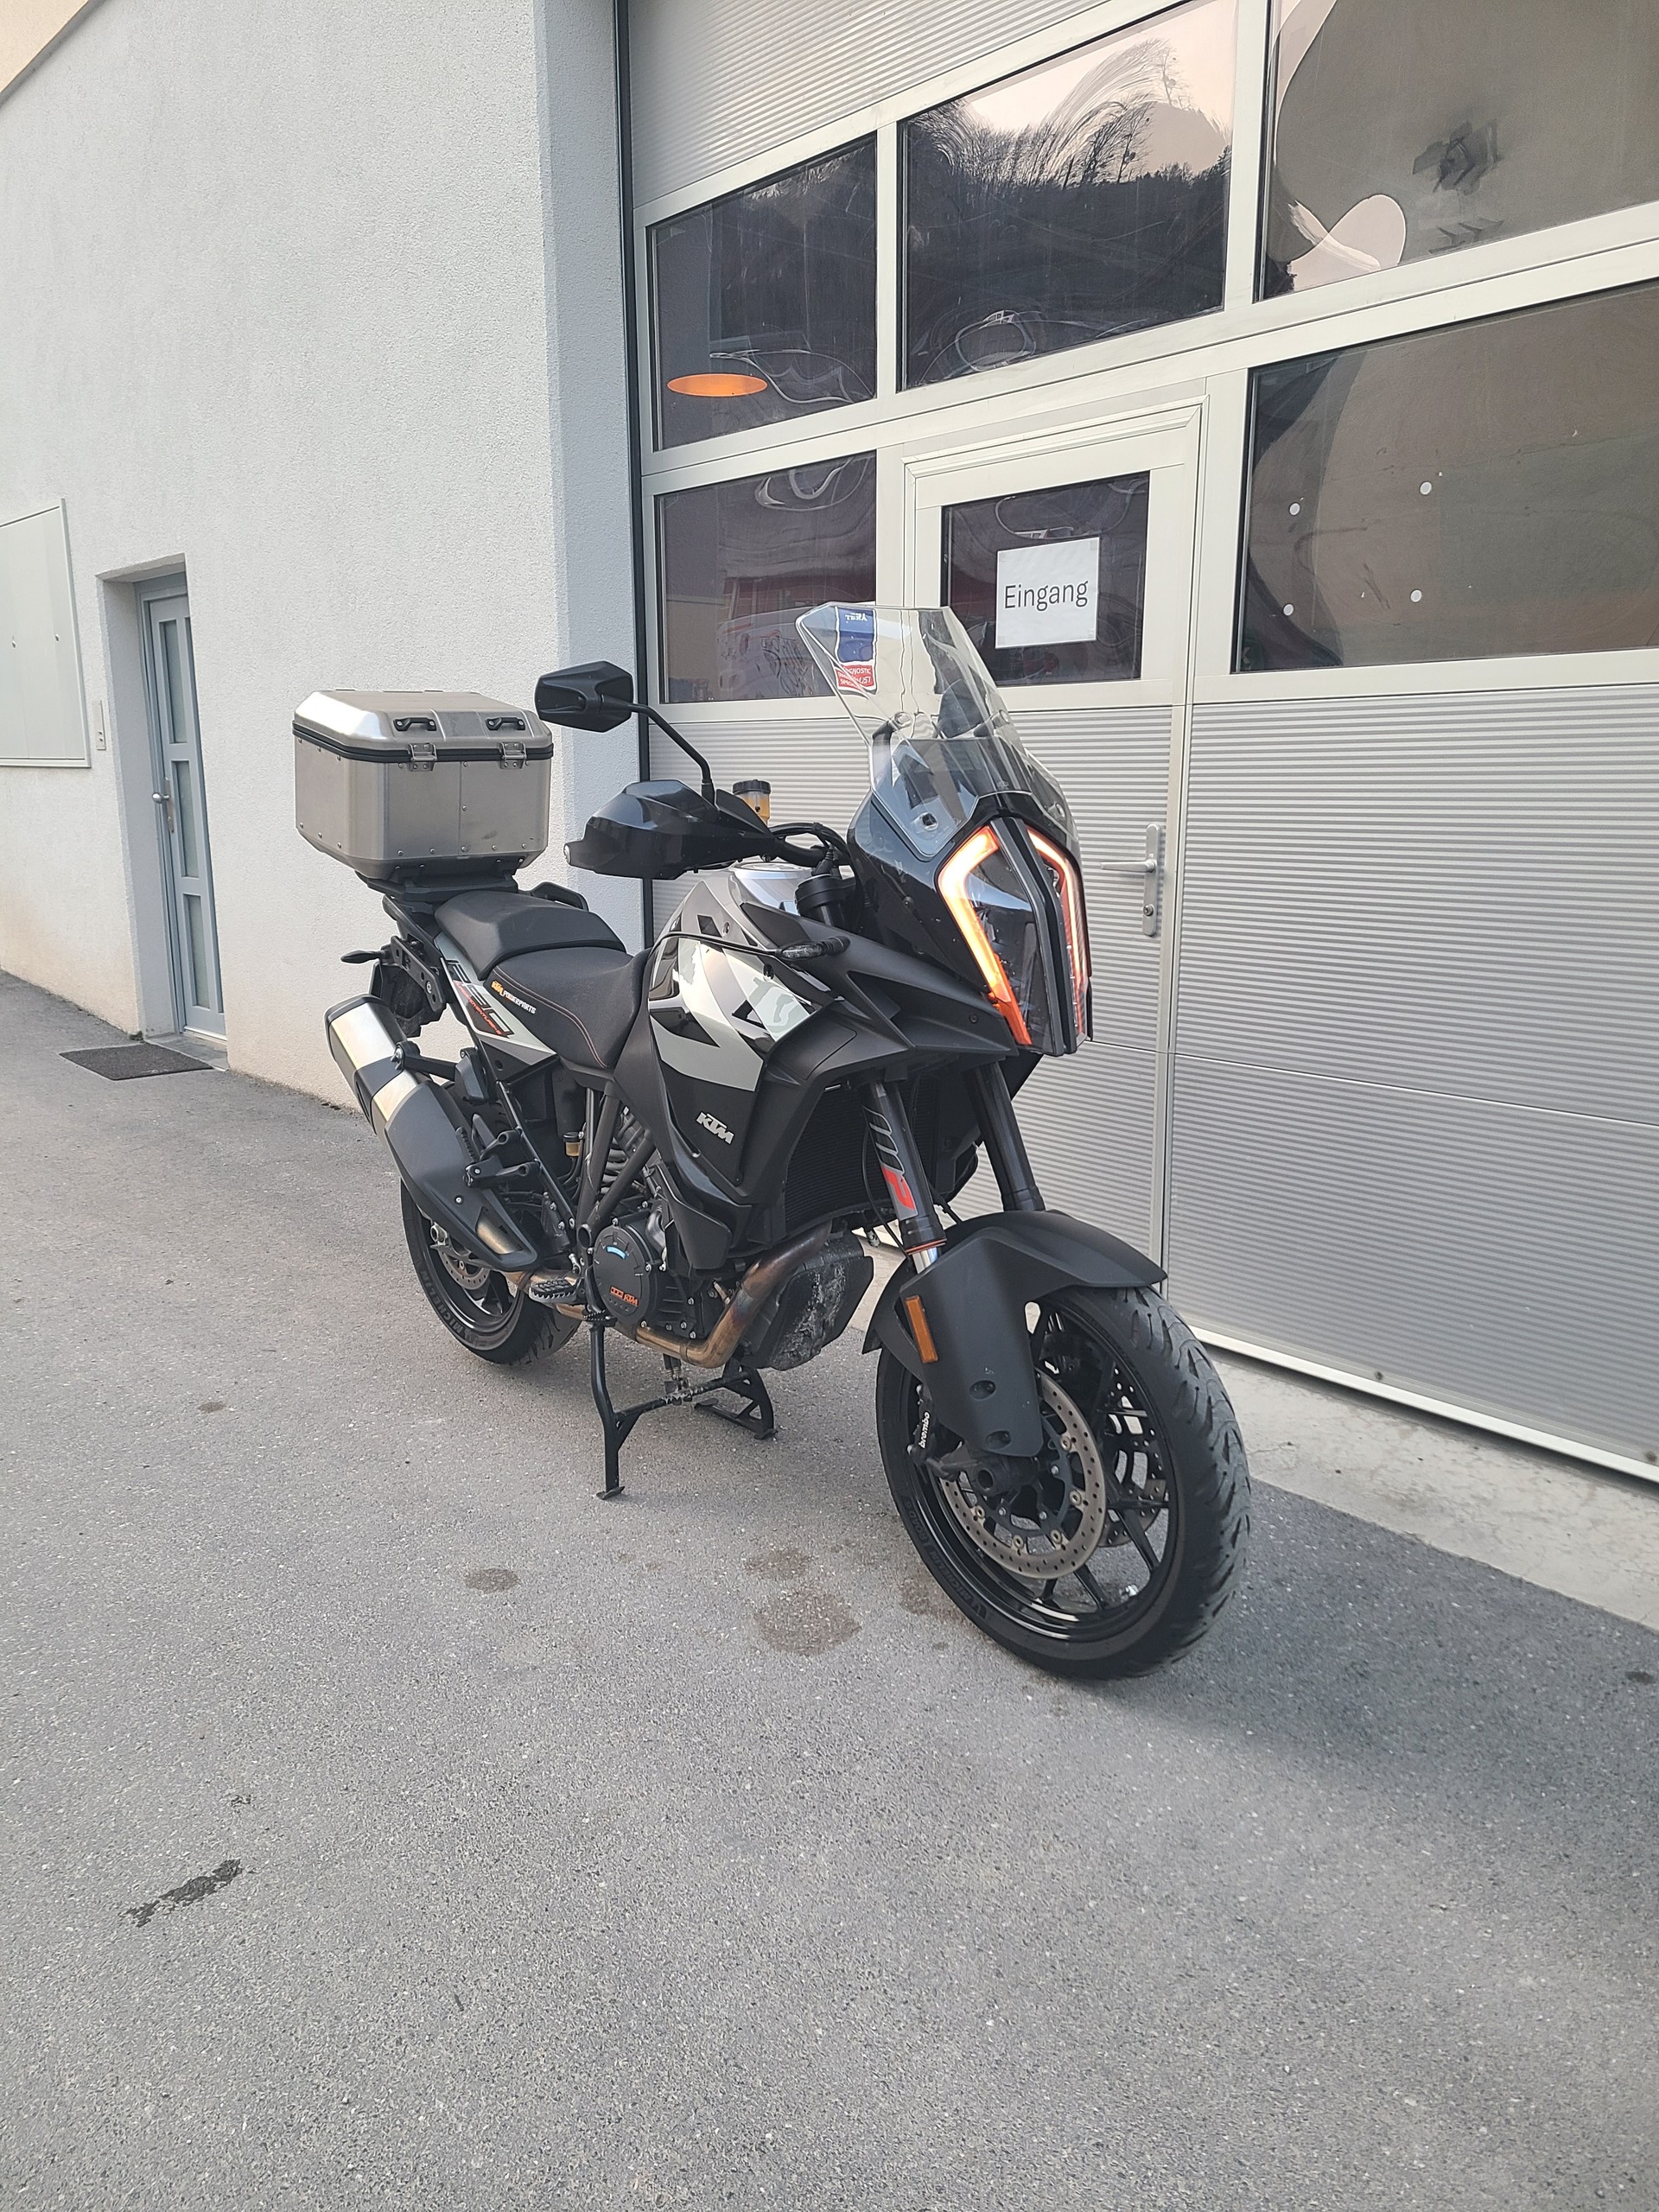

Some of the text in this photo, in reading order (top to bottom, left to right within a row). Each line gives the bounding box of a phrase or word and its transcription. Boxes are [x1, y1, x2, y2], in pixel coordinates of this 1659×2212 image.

[1005, 581, 1088, 612] Eingang
[503, 990, 537, 1014] POWERPARTS
[696, 1112, 734, 1144] KTM
[420, 1271, 463, 1333] MICHELIN
[623, 1294, 639, 1306] KTM
[918, 1412, 930, 1449] brembo
[930, 1549, 973, 1604] MICHELIN
